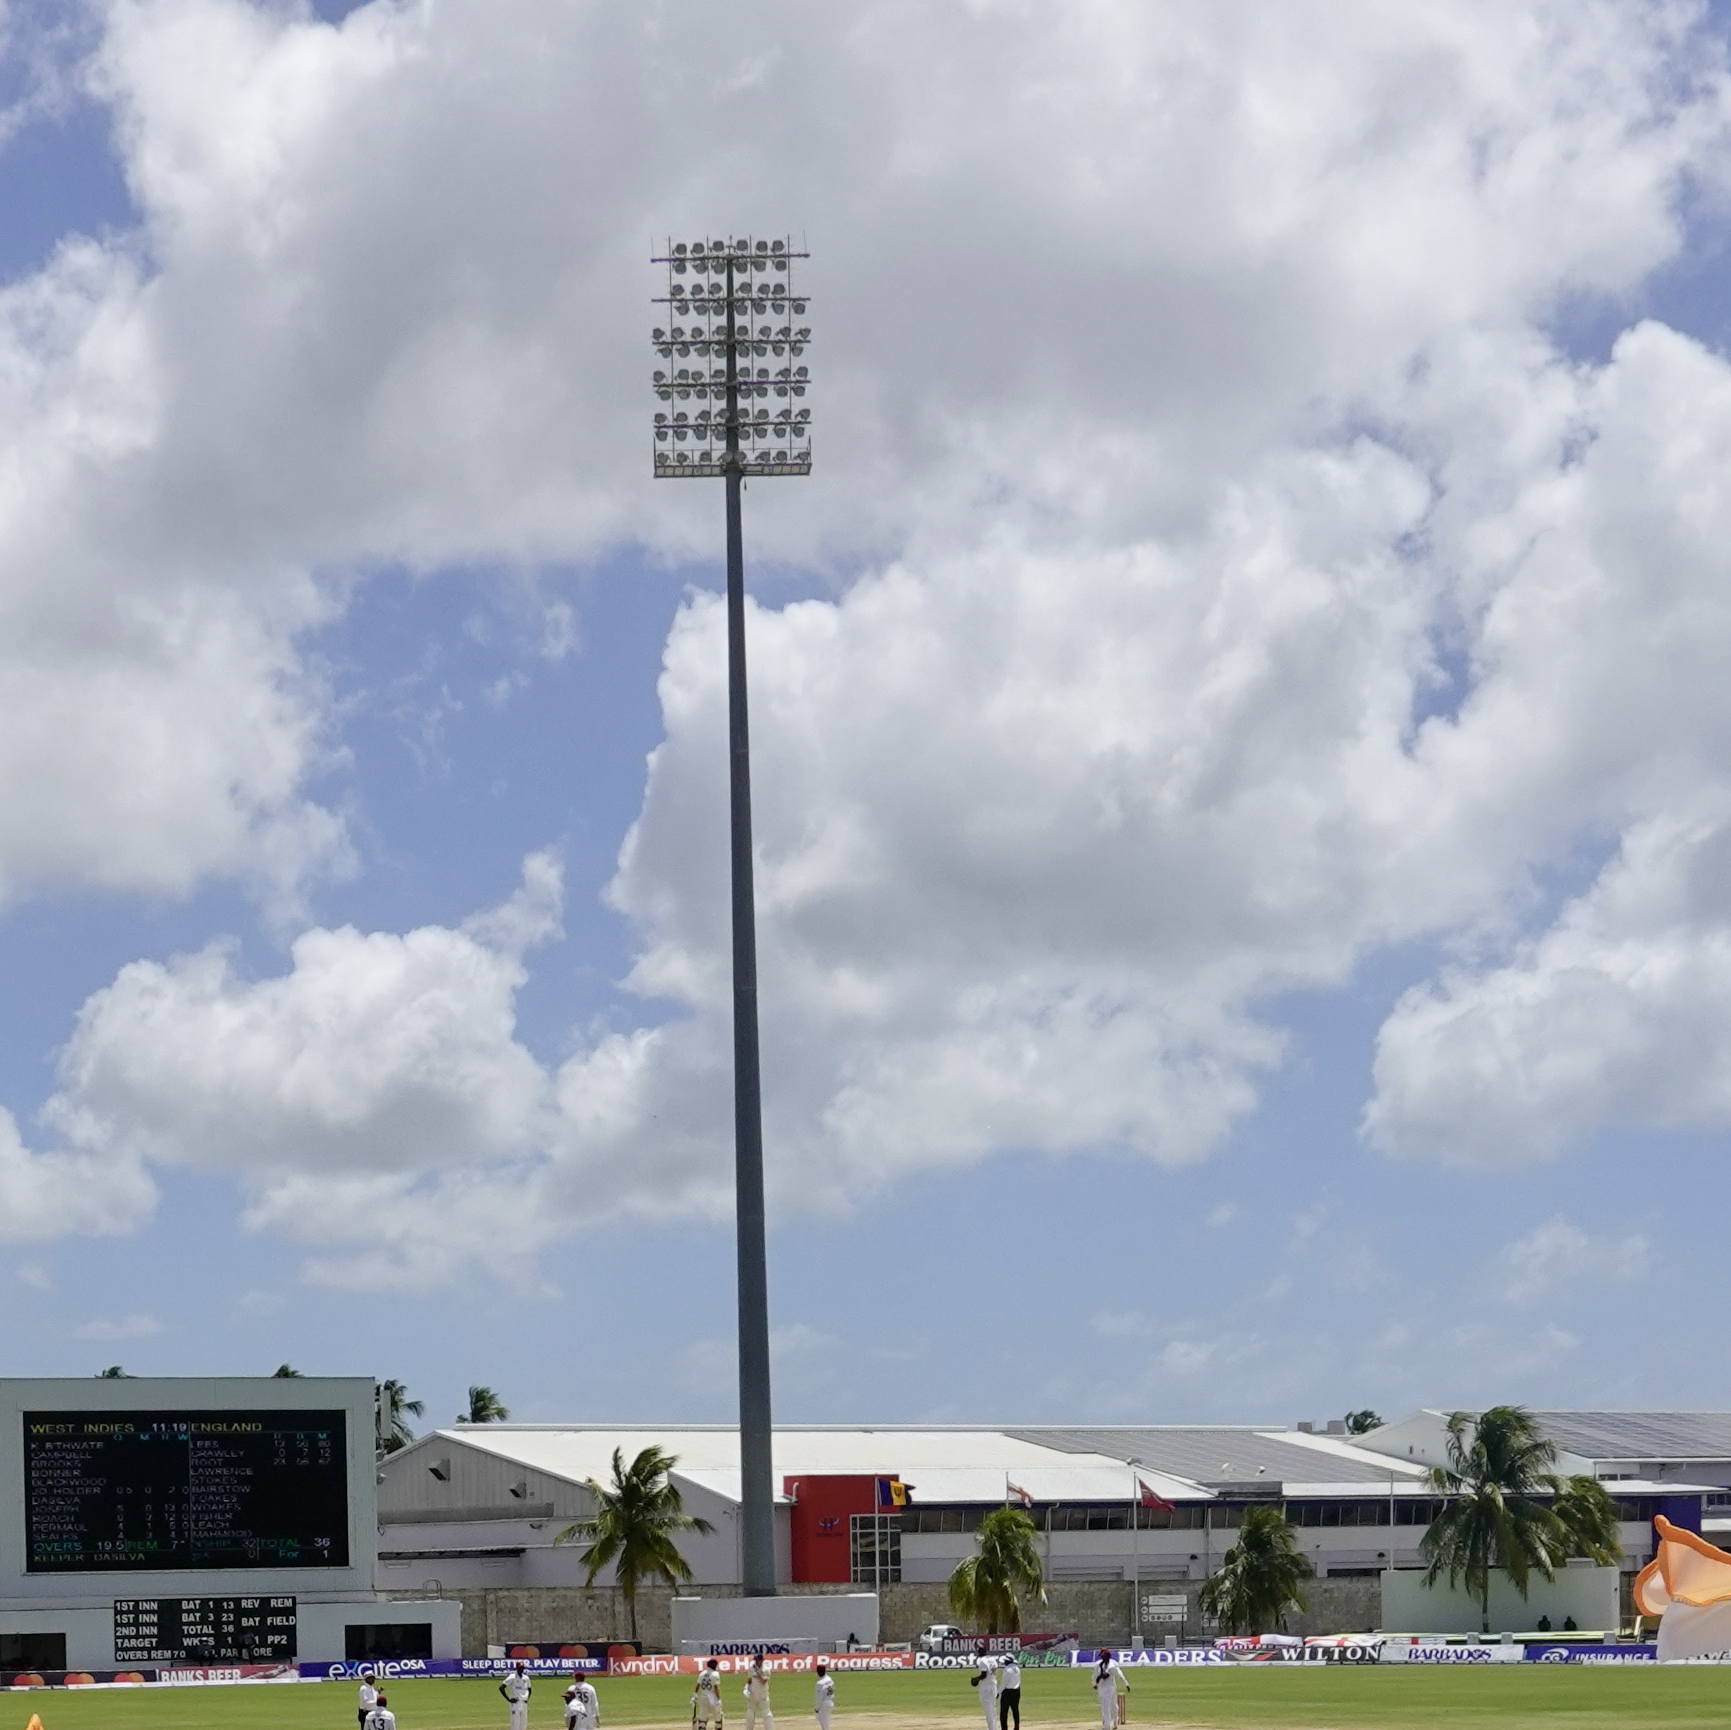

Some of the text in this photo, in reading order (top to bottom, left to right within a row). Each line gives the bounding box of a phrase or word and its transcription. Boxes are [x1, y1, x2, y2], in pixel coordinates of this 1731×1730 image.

[30, 1424, 75, 1433] WEST
[84, 1424, 135, 1433] INDIES
[191, 1423, 262, 1432] ENGLAND
[34, 1542, 82, 1551] OVERS
[261, 1538, 330, 1547] TOTAL 36
[116, 1602, 135, 1611] 1ST
[139, 1602, 158, 1610] INN
[182, 1601, 200, 1609] BAT
[241, 1600, 260, 1608] REV
[270, 1599, 292, 1607] REM
[116, 1613, 295, 1626] 1ST INN BAT 3 23 BAT FIELD
[116, 1627, 136, 1636] 2ND
[139, 1626, 158, 1635] INN
[182, 1625, 214, 1634] TOTAL
[116, 1639, 158, 1647] TARGET
[268, 1636, 287, 1644] PP2
[944, 1637, 1020, 1651] BANKS BEER
[116, 1651, 148, 1659] OVERS
[151, 1650, 171, 1659] REM
[221, 1648, 238, 1657] PAR
[1105, 1650, 1222, 1664] EADERS
[1282, 1647, 1380, 1661] WILTON
[1408, 1648, 1492, 1660] BARBADOS
[1576, 1653, 1651, 1662] INSURANCE
[400, 1660, 425, 1670] OSA
[462, 1660, 491, 1669] SLEEP
[534, 1659, 559, 1668] PLAY
[562, 1658, 601, 1667] BETTER.
[694, 1657, 730, 1671] Te
[793, 1656, 813, 1669] of
[161, 1669, 241, 1681] BANKS BEER
[371, 1718, 385, 1730] 13
